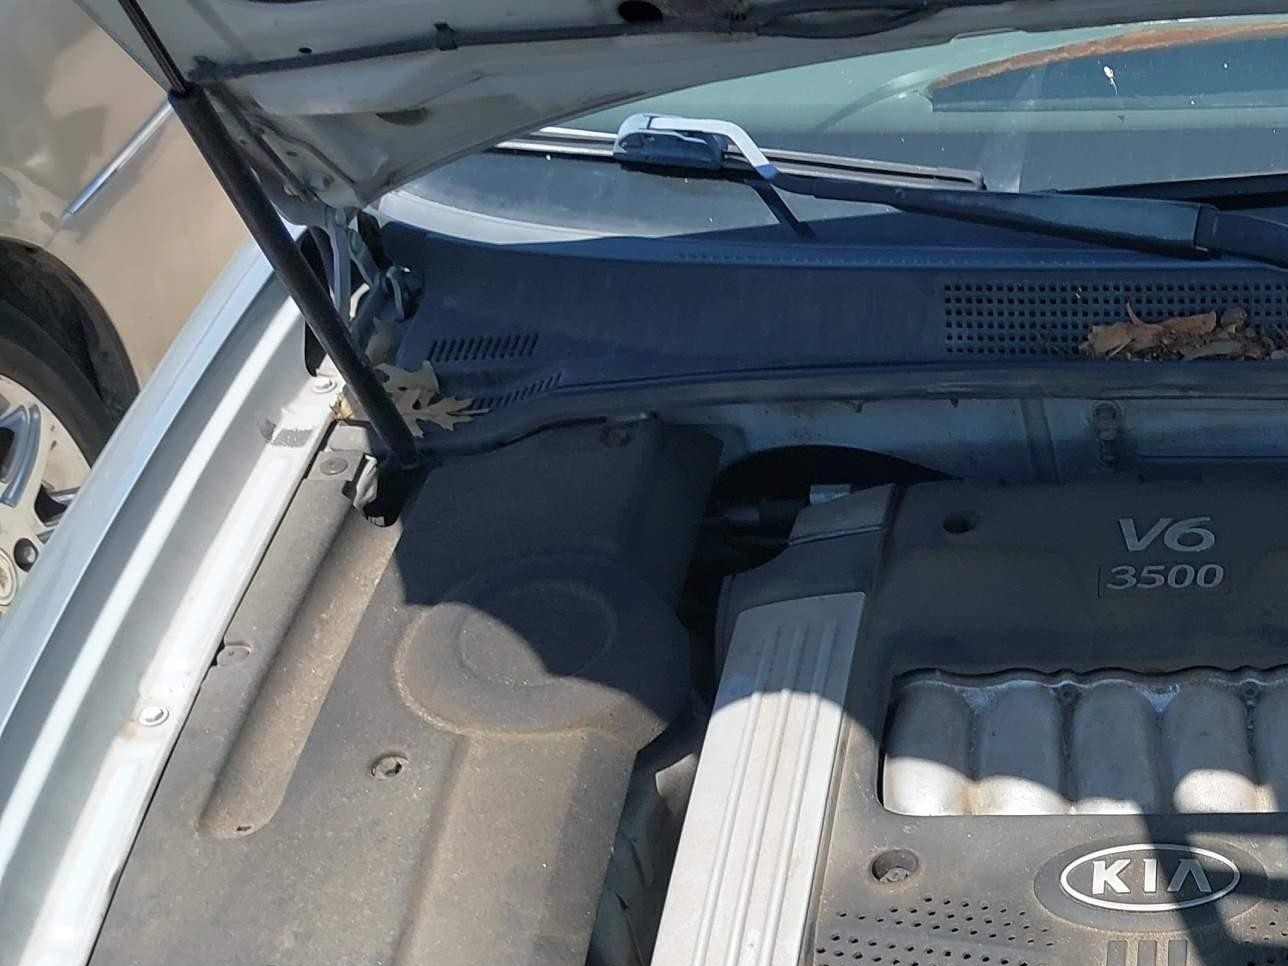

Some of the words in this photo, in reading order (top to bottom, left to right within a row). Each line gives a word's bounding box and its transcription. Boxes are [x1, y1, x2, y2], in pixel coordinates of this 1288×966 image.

[1119, 516, 1215, 552] V6
[1107, 564, 1224, 589] 3500
[1092, 859, 1212, 895] KIA
